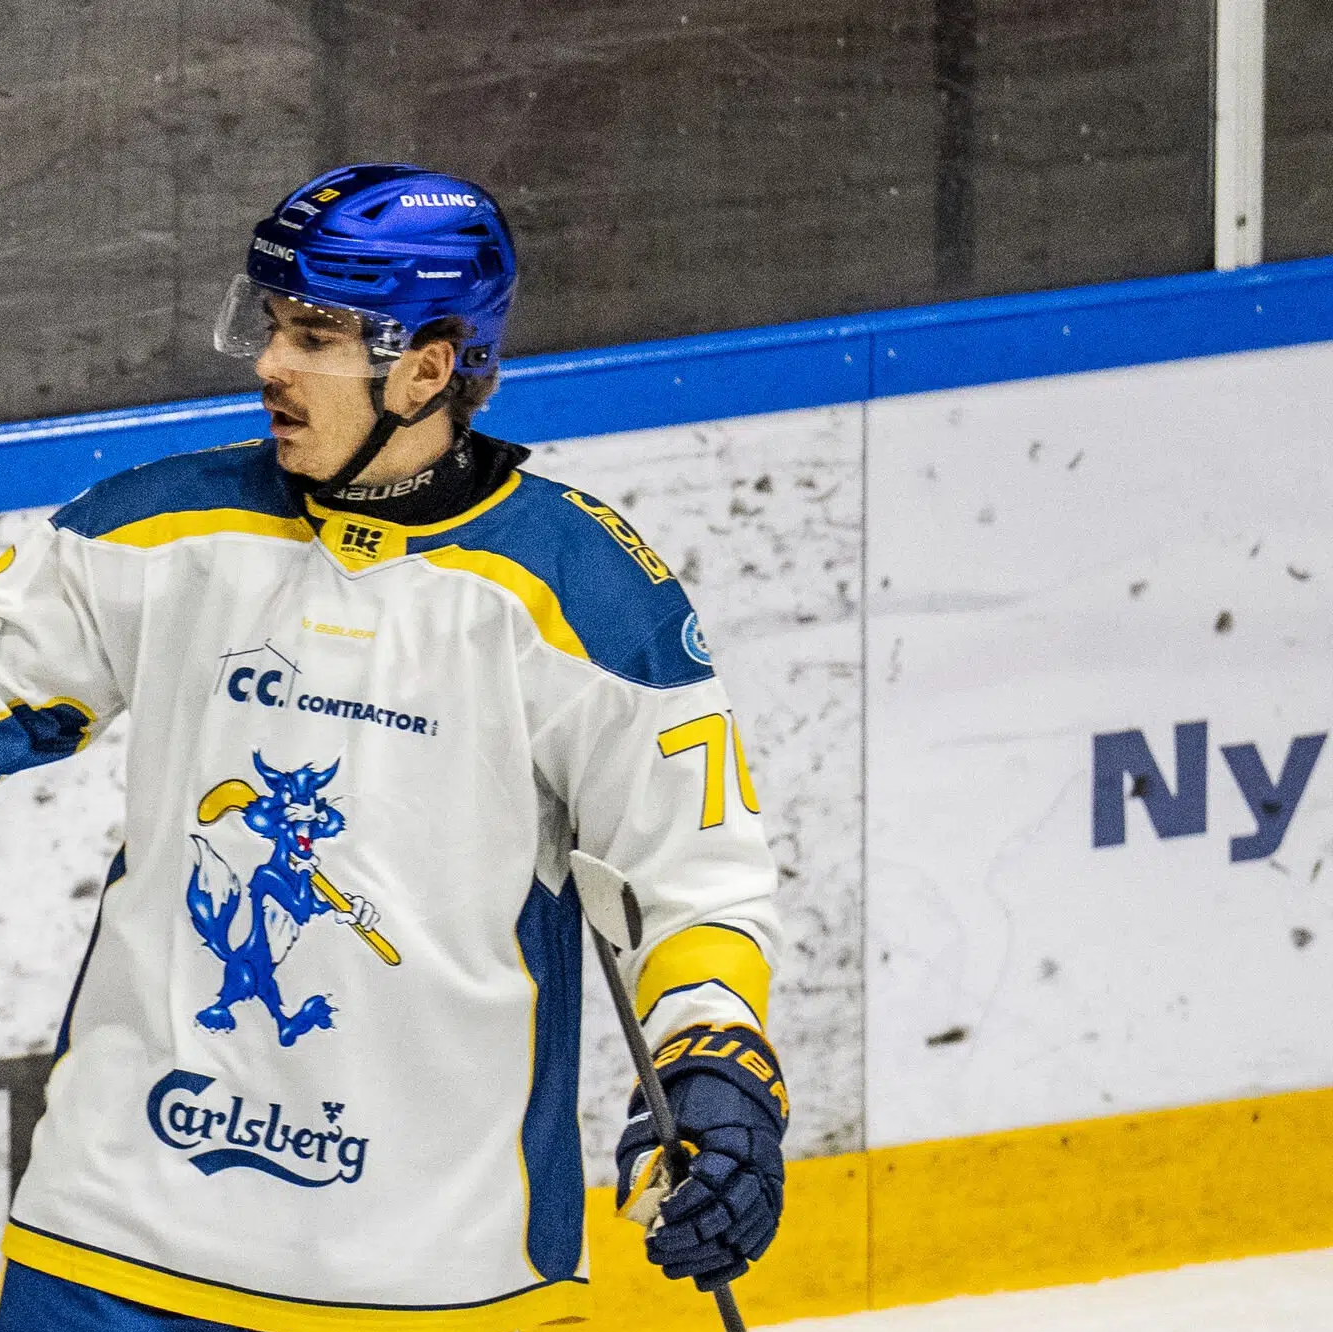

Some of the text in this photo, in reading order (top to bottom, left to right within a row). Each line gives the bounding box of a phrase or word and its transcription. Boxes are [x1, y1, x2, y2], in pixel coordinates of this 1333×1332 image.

[400, 193, 476, 208] DILLING
[253, 237, 295, 262] DILLING
[297, 694, 428, 735] CONTRACTOR
[657, 709, 760, 829] 7
[1090, 719, 1329, 863] Ny
[633, 1035, 790, 1119] AUER
[146, 1068, 370, 1188] Carlsberg
